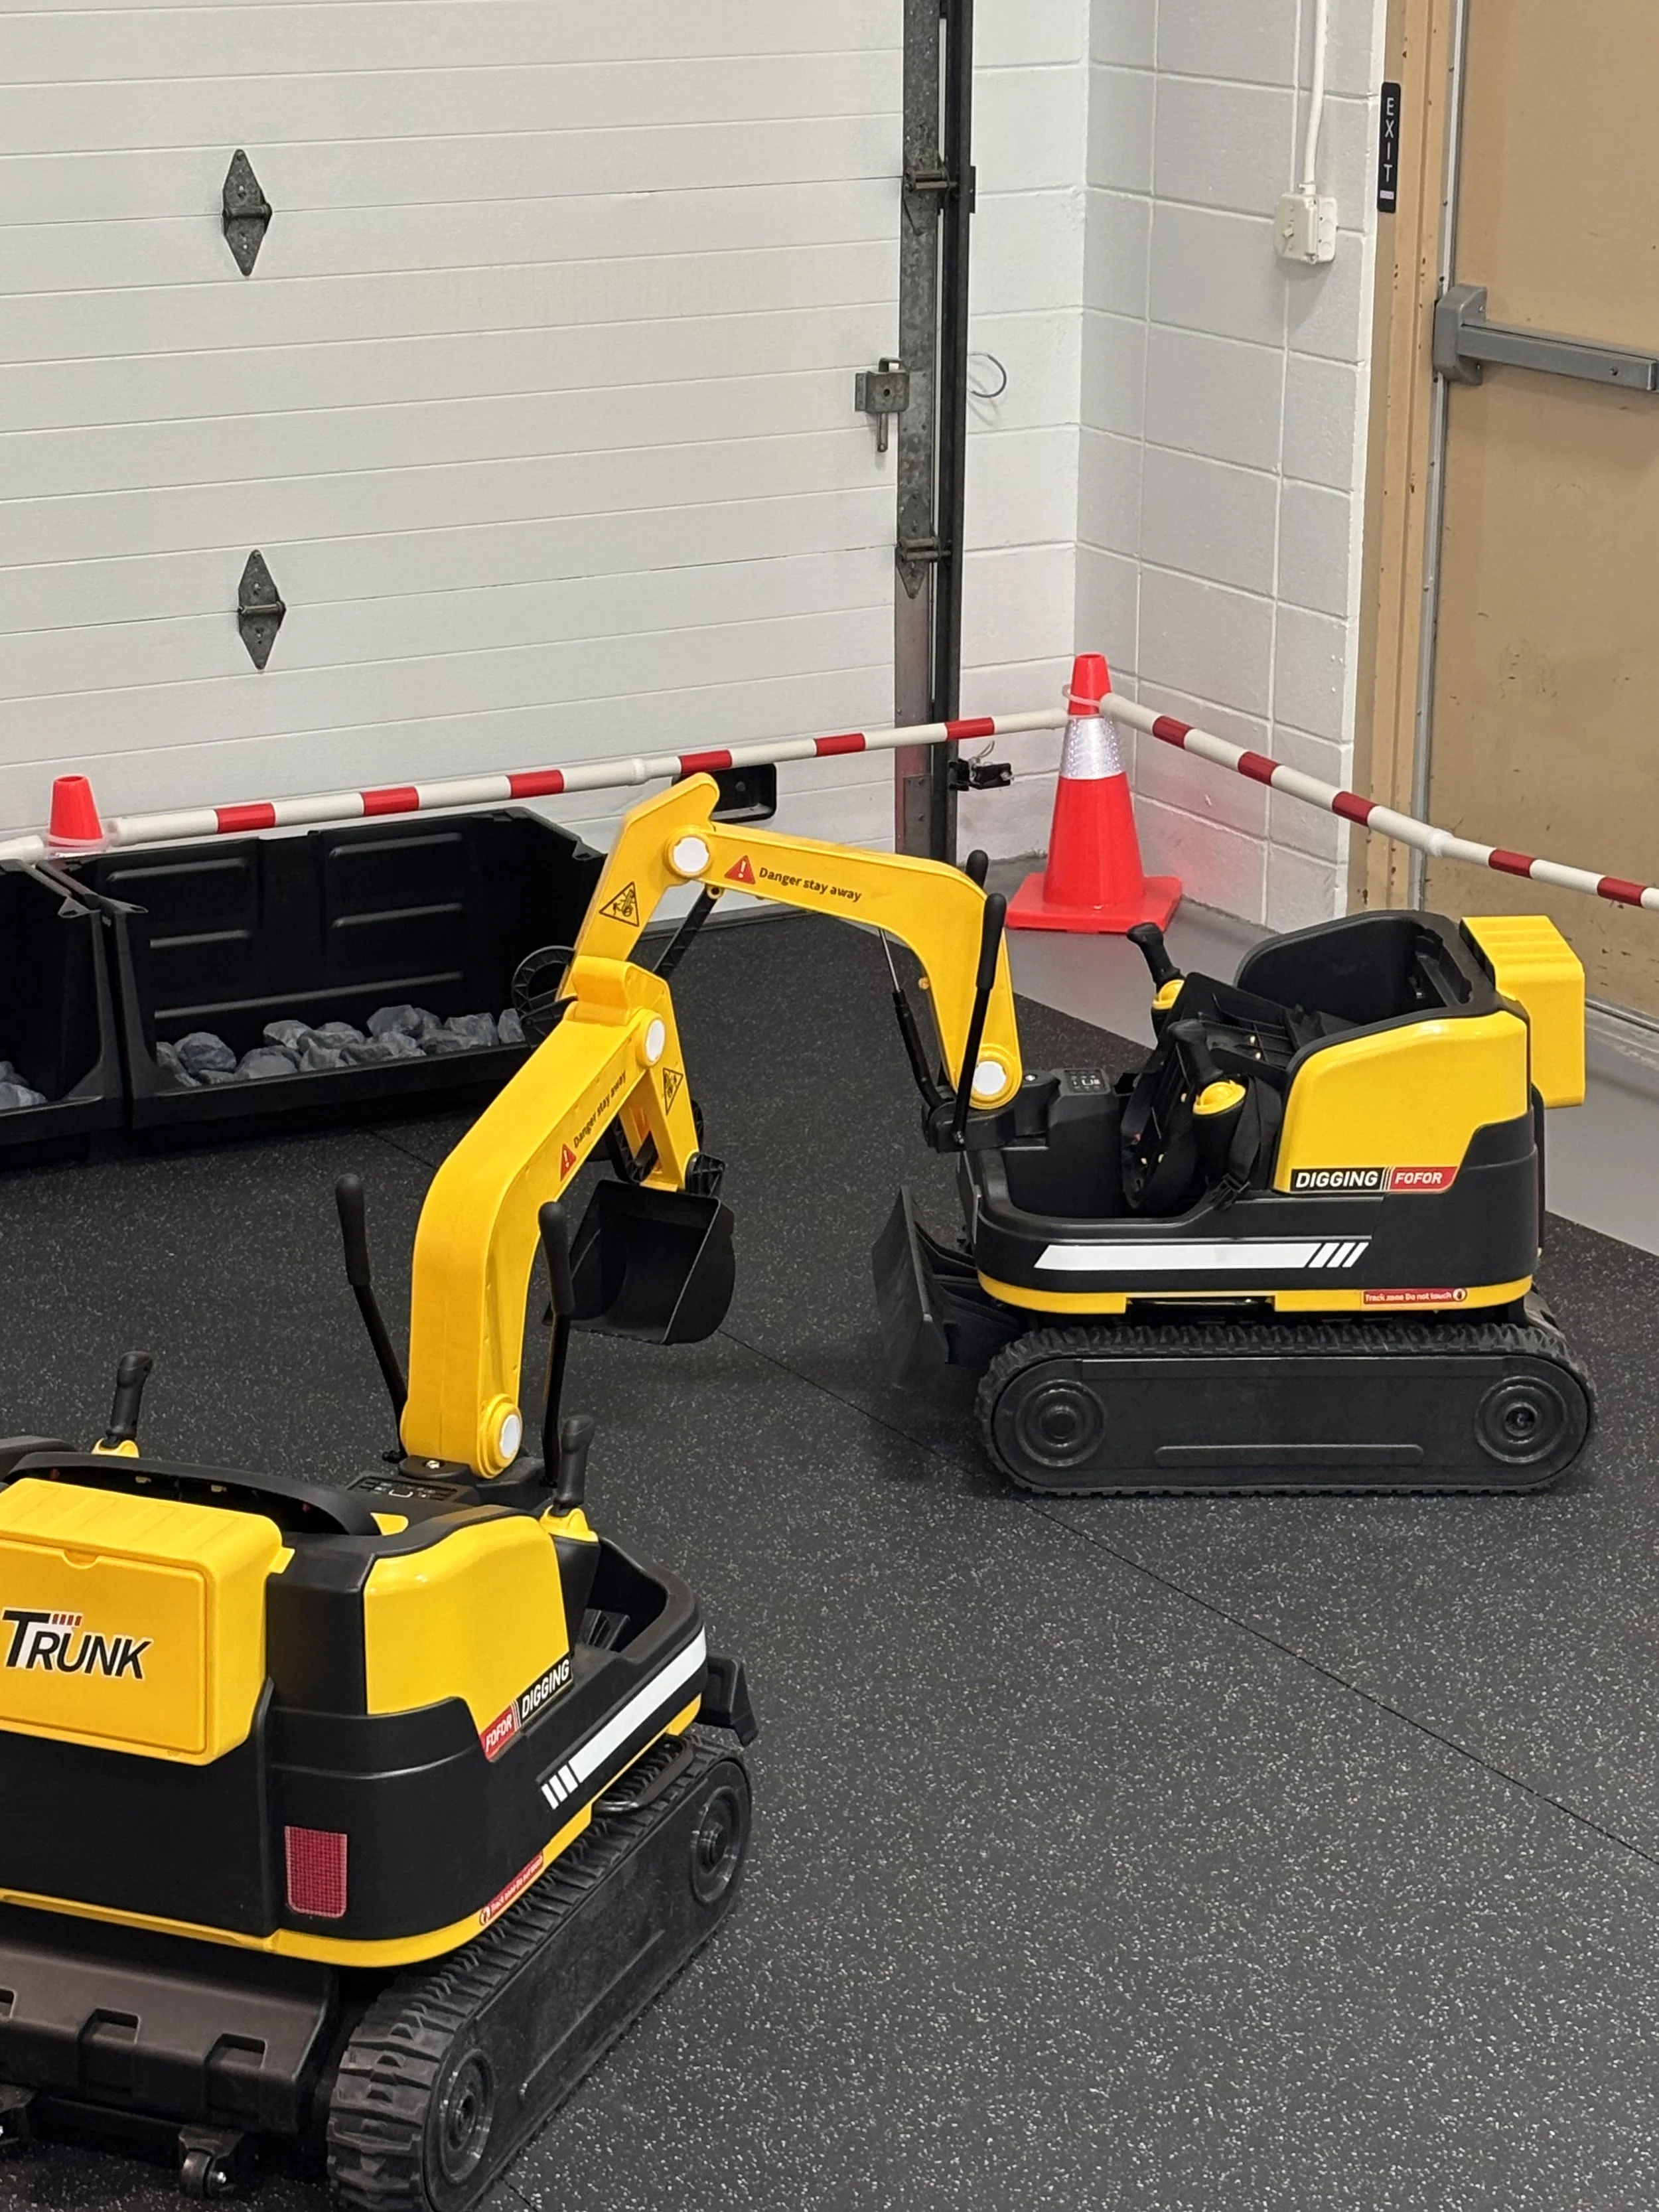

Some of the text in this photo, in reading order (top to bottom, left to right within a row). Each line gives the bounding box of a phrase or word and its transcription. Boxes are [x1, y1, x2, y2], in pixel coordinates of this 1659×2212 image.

[1384, 98, 1394, 183] EXIT
[758, 867, 862, 903] Danger stay away
[573, 1070, 626, 1149] Danger stay away
[1295, 1171, 1443, 1188] DIGGING FOFOR
[2, 1609, 152, 1679] TRUNK
[486, 1659, 569, 1753] FOFOR DIGGING
